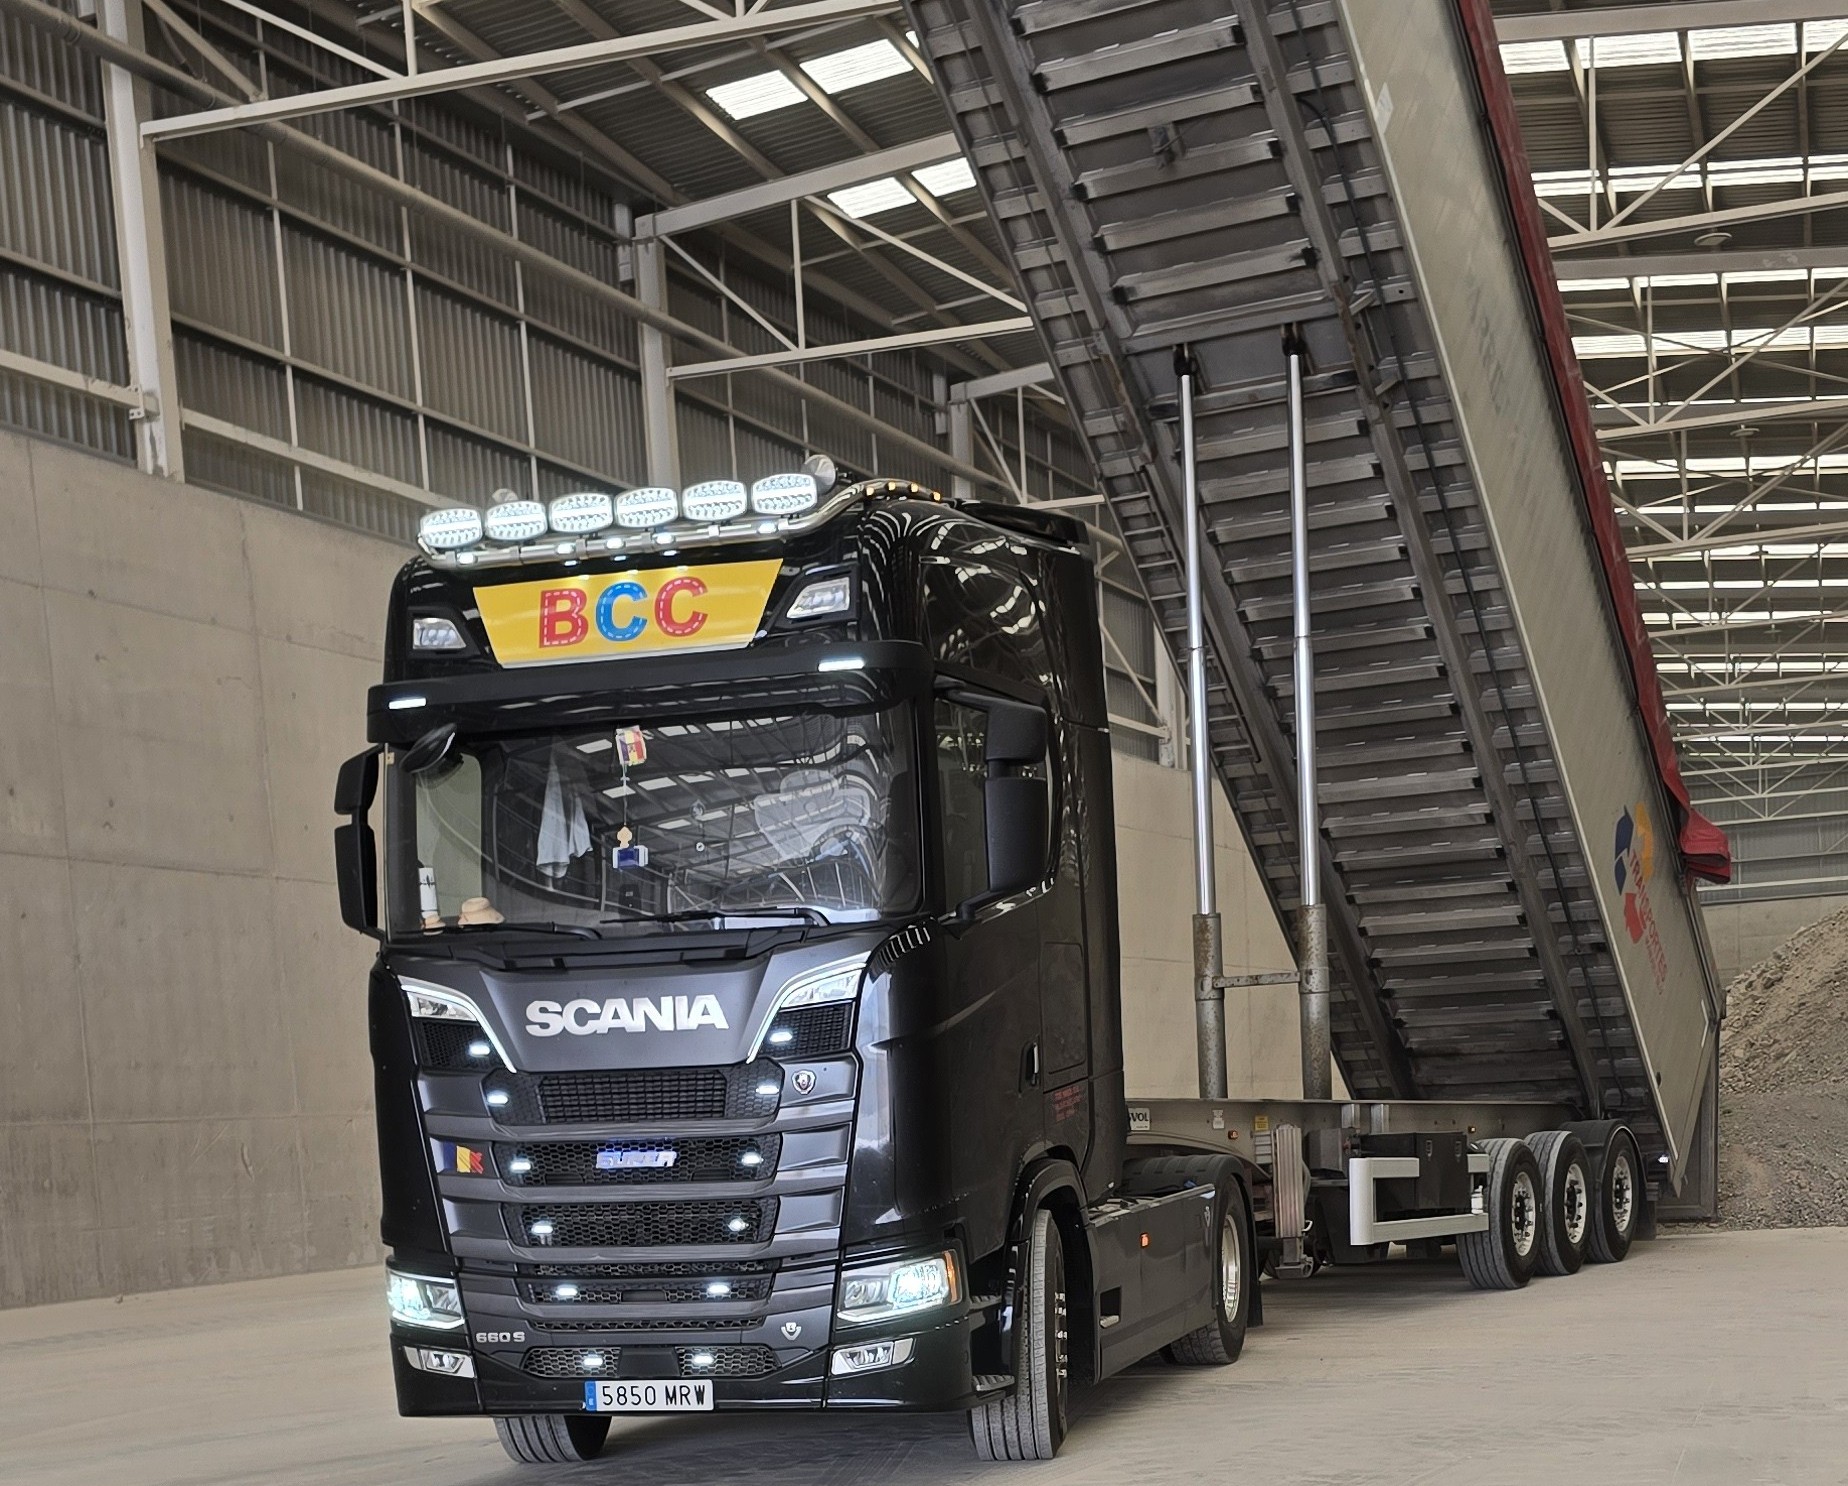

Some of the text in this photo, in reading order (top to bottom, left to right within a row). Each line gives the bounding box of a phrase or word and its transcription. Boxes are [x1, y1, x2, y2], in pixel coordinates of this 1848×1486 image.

[539, 576, 709, 648] BCC
[526, 994, 729, 1037] SCANIA
[475, 1331, 526, 1343] 660 S
[602, 1384, 706, 1406] 5850 MRW
